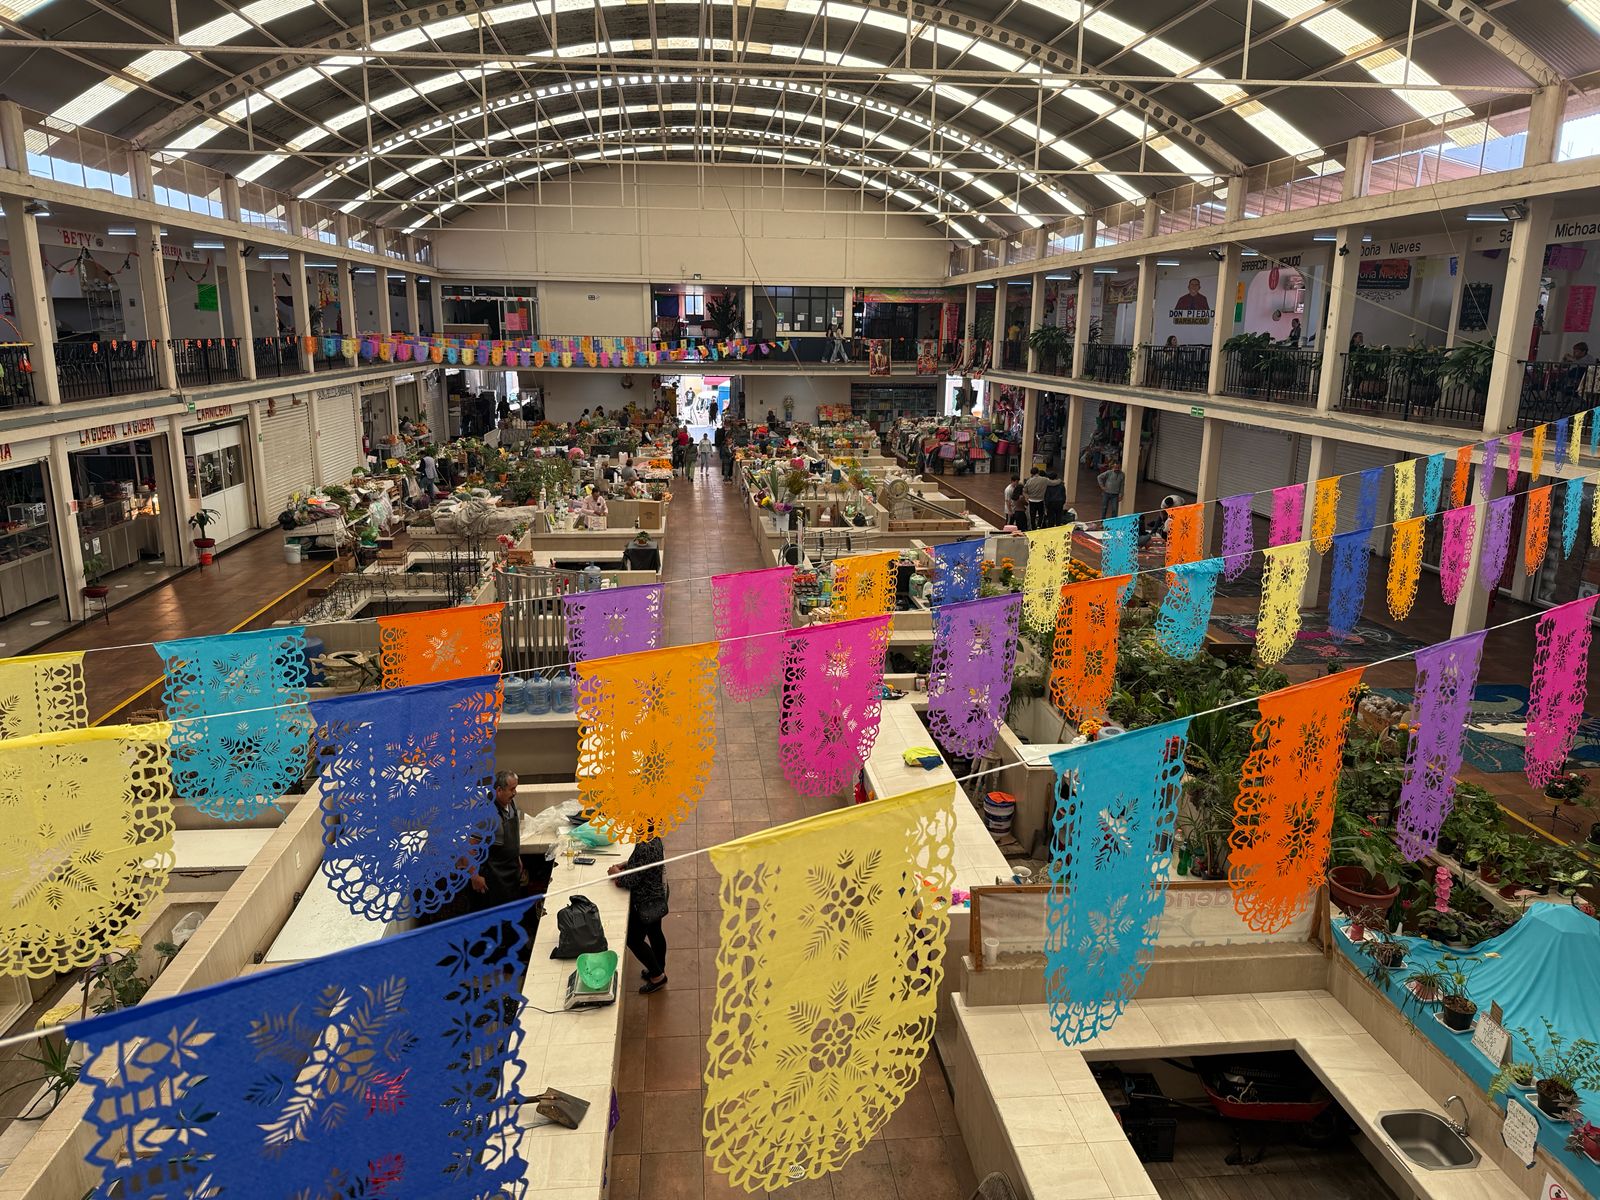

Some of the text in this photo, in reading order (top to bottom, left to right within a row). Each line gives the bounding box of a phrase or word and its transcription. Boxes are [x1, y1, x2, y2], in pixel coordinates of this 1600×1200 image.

[1389, 242, 1421, 255] Nieves
[1169, 310, 1216, 318] DON PIEDAD
[79, 429, 90, 446] LA
